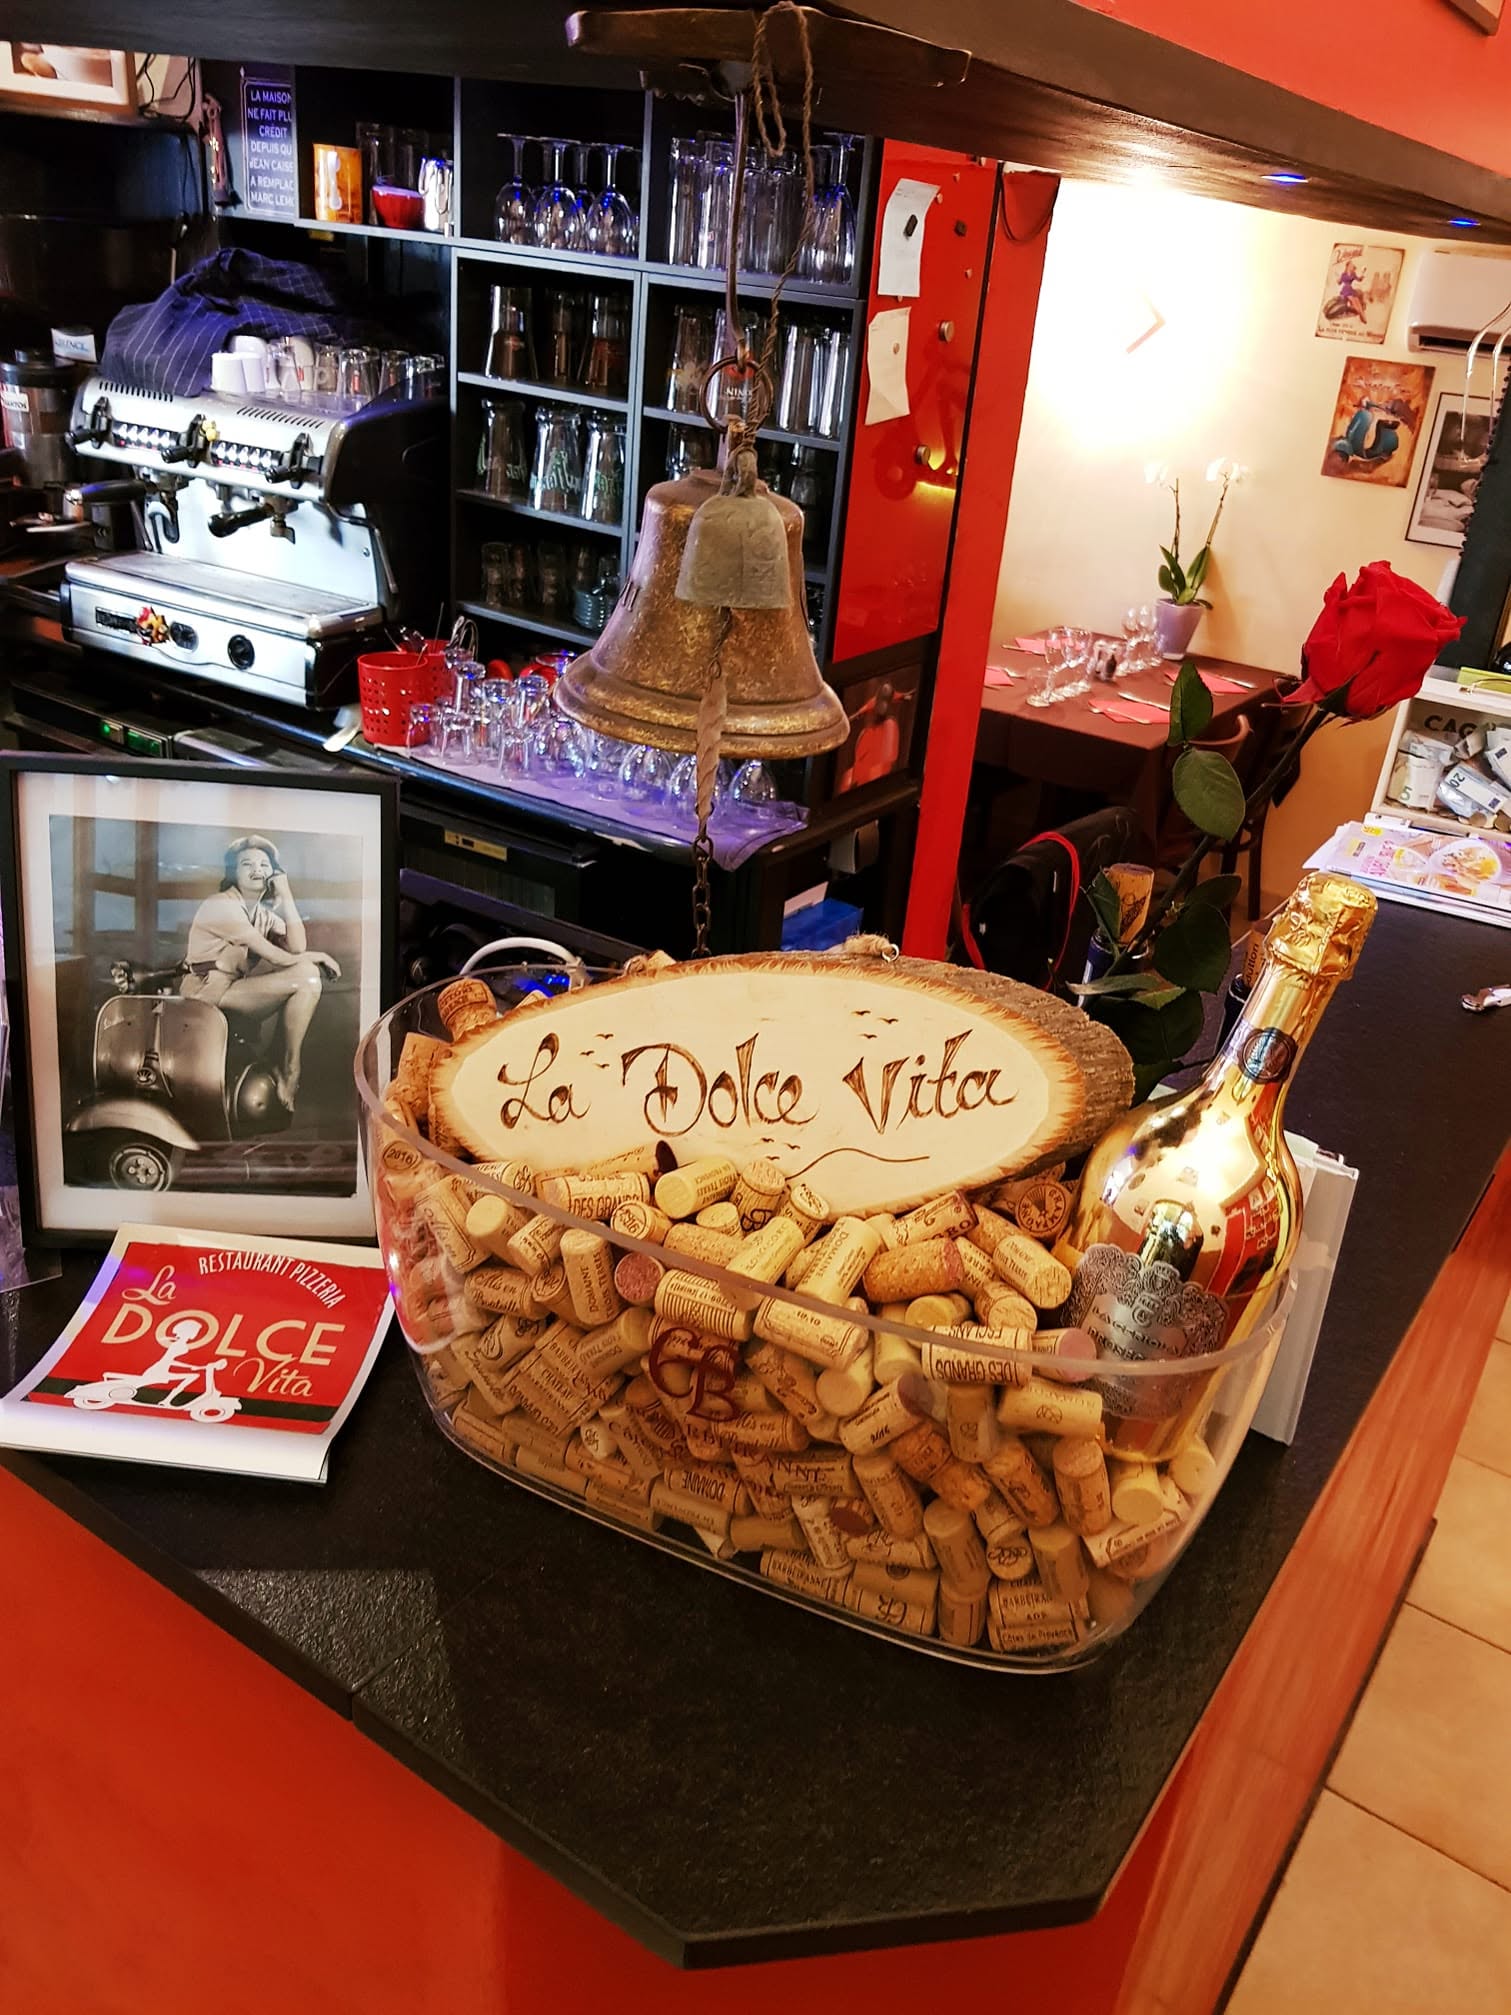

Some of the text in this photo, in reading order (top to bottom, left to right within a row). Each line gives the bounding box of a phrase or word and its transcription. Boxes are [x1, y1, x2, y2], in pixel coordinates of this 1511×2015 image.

[251, 90, 261, 102] LA
[248, 108, 258, 120] NE
[260, 109, 277, 121] FAIT
[250, 140, 279, 155] DEPUIS
[250, 175, 257, 187] A
[1449, 772, 1466, 789] 20
[1400, 785, 1413, 801] 5
[497, 1029, 1018, 1138] La Dolce Vita
[388, 1150, 414, 1164] 2016
[572, 1195, 597, 1220] DES
[815, 1229, 849, 1280] DOMAINE
[121, 1265, 177, 1306] La
[199, 1250, 347, 1309] RESTAURANT PIZZERIA
[101, 1303, 345, 1367] DOLCE
[233, 1357, 313, 1397] Vita
[935, 1359, 1012, 1379] DES GRANDS
[679, 1470, 726, 1501] DOMAINE
